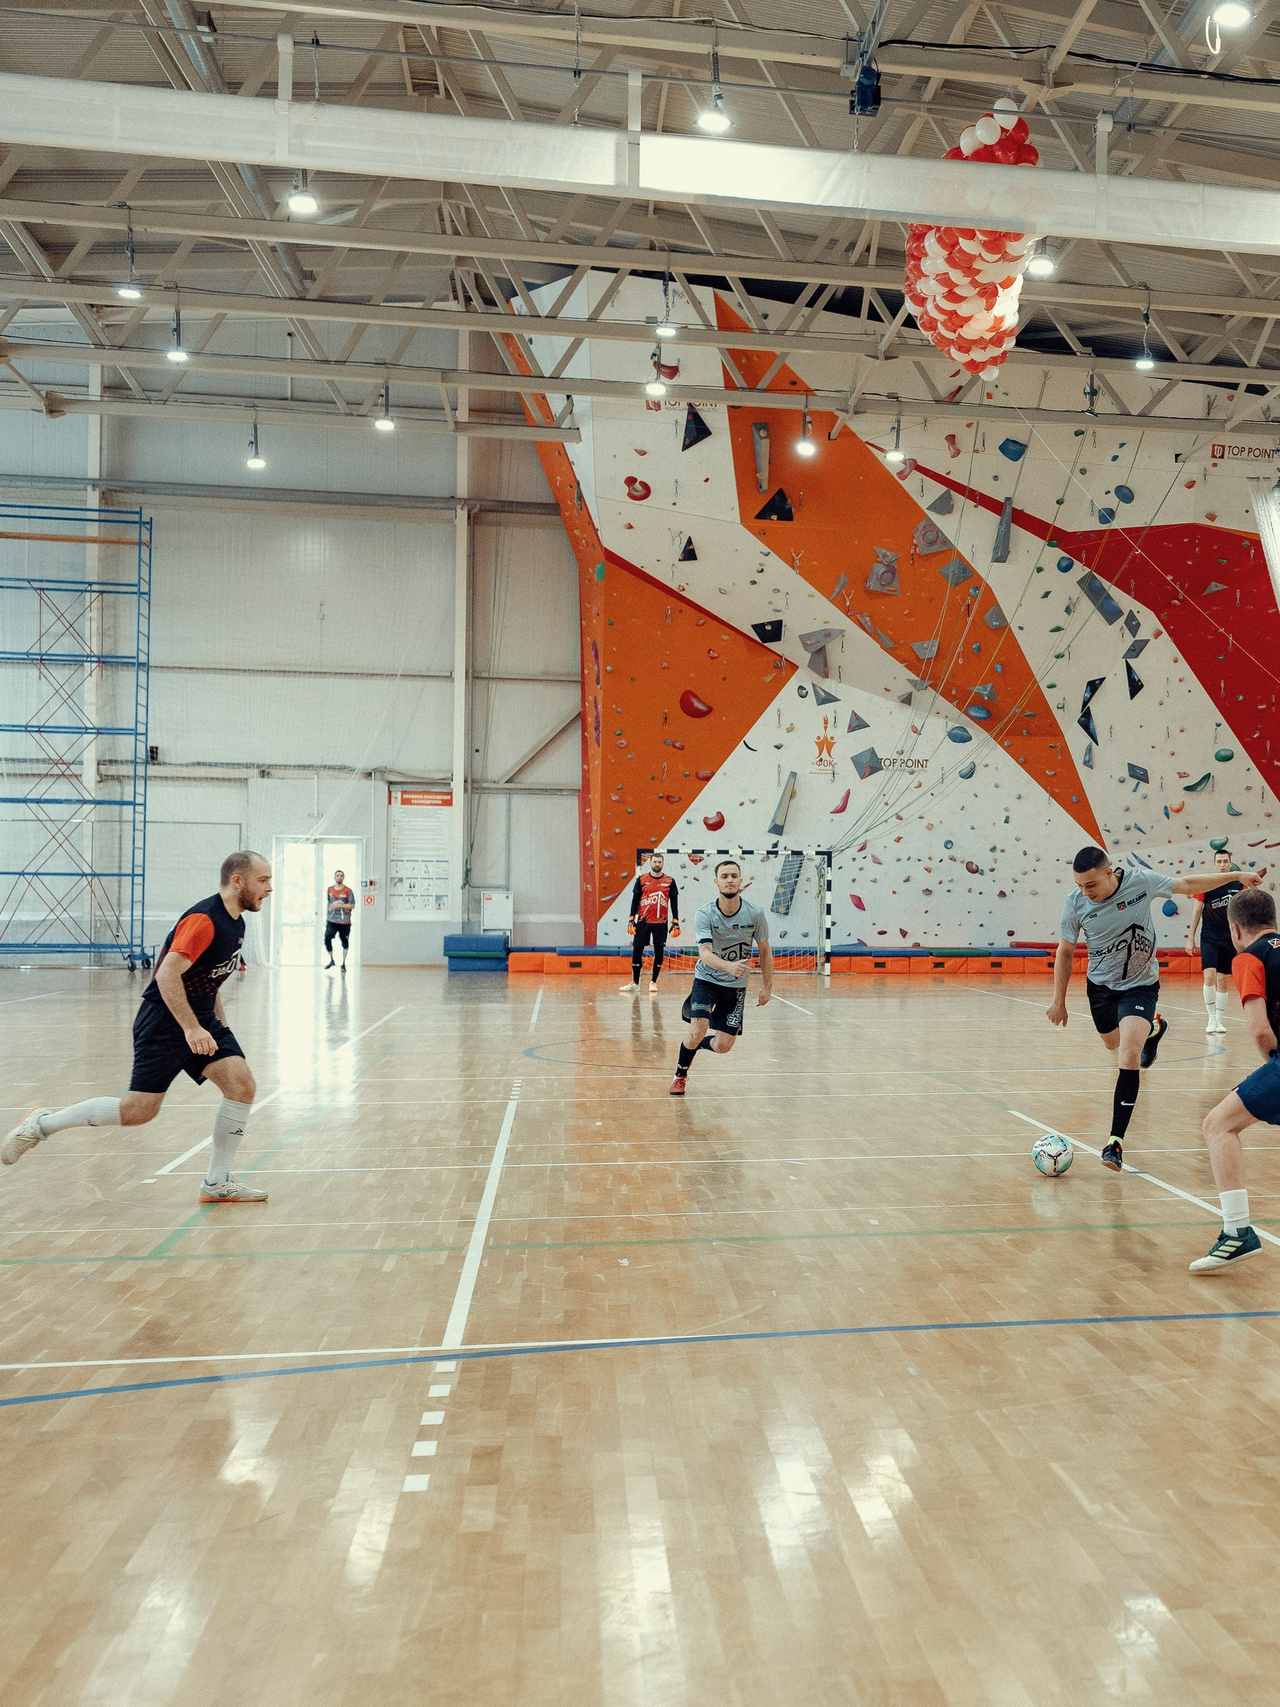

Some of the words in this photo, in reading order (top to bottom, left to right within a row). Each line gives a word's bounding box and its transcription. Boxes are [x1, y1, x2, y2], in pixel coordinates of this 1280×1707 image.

[1227, 445, 1246, 457] TOP
[1247, 447, 1276, 460] POINT
[900, 758, 929, 769] POINT
